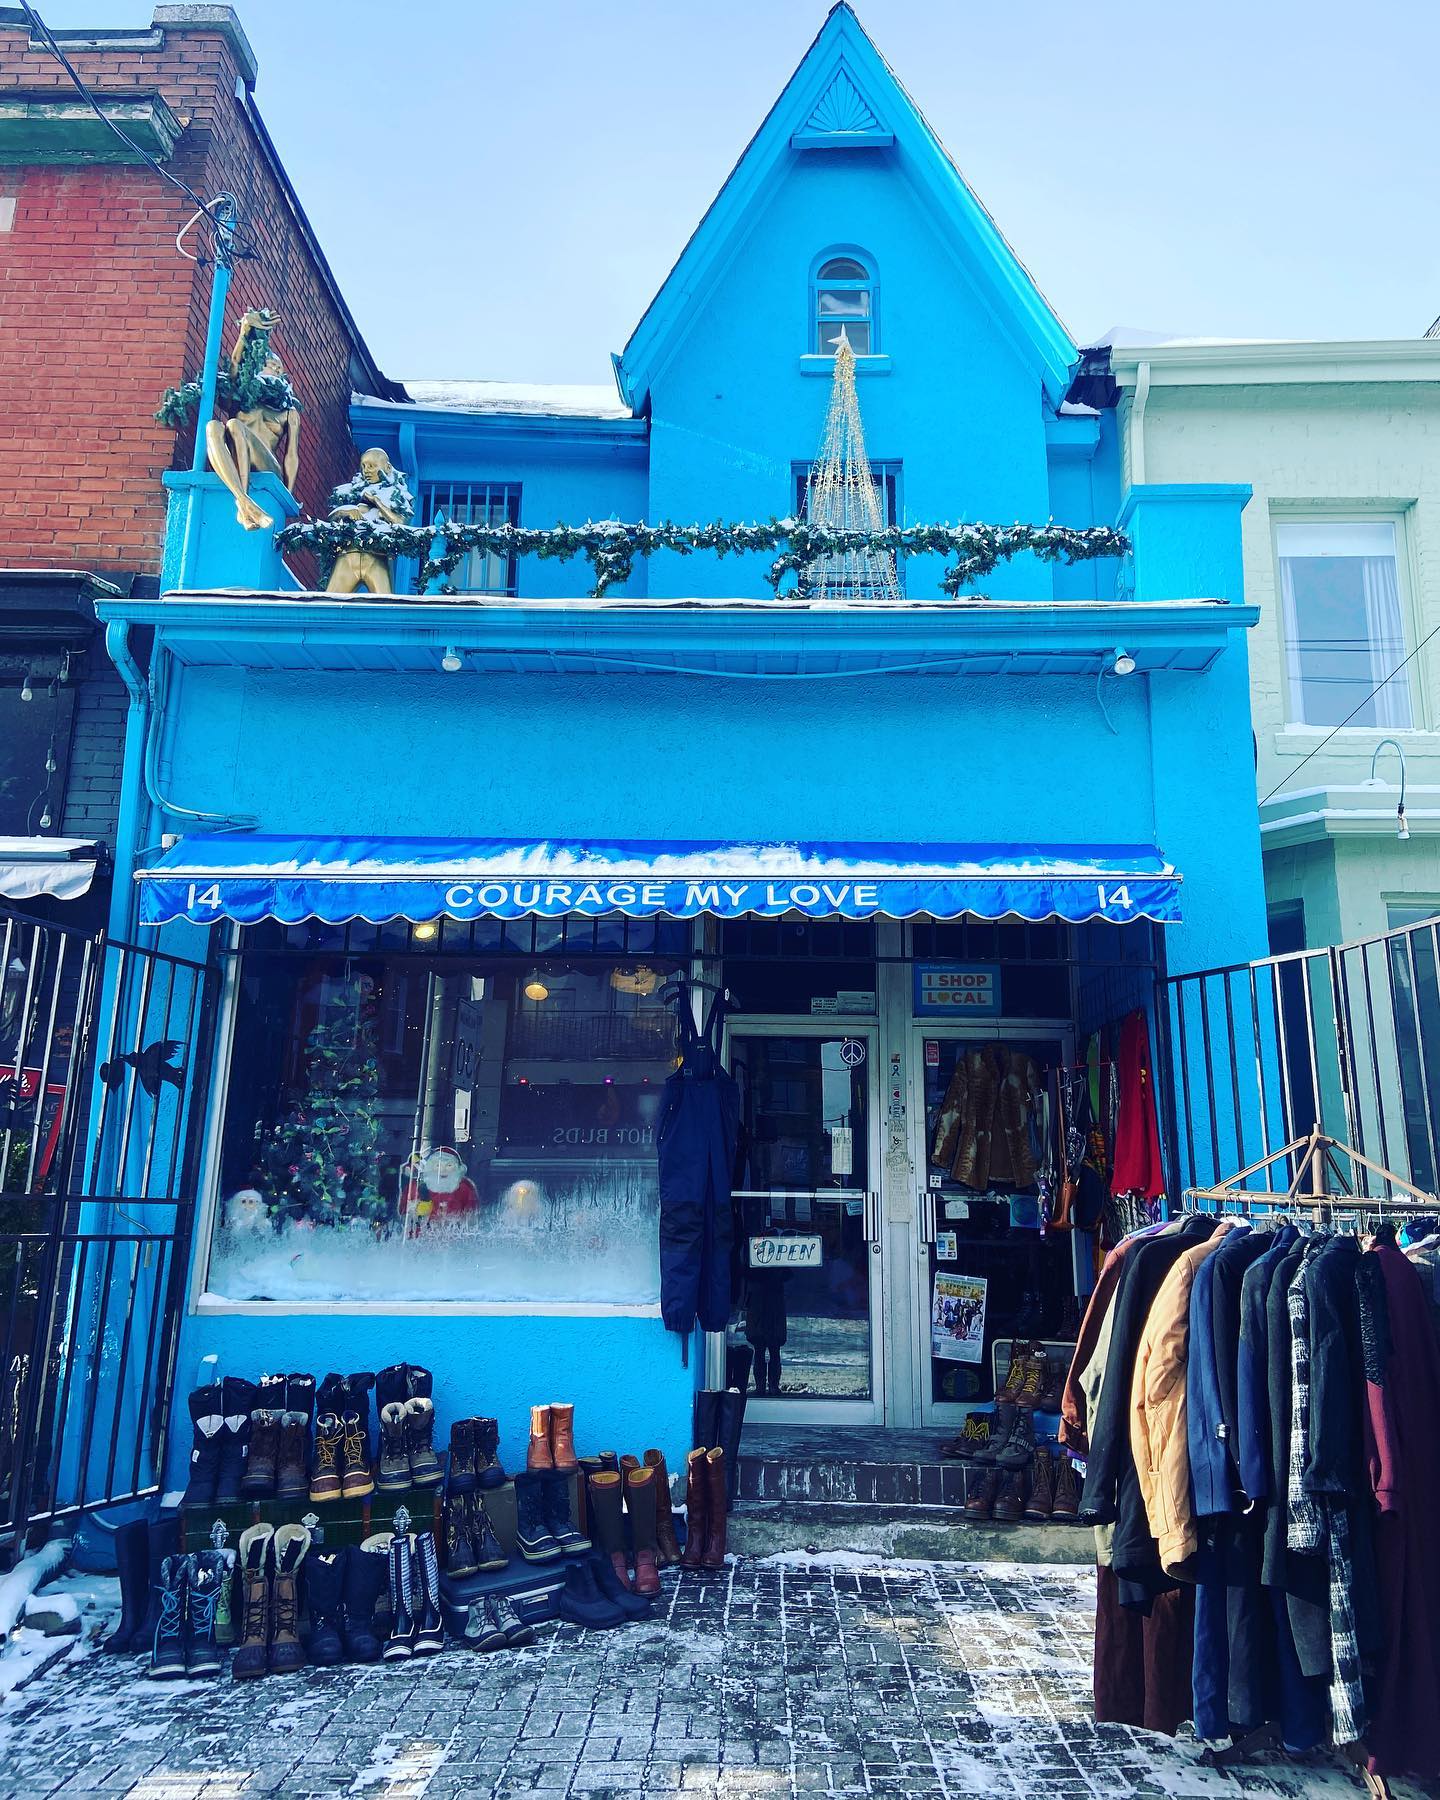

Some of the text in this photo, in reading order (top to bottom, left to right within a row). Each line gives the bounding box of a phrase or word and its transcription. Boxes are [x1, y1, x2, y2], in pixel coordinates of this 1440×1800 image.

[187, 883, 222, 910] 14
[445, 884, 879, 908] COURAGE MY LOVE
[1097, 884, 1134, 909] 14
[938, 974, 988, 987] SHOP
